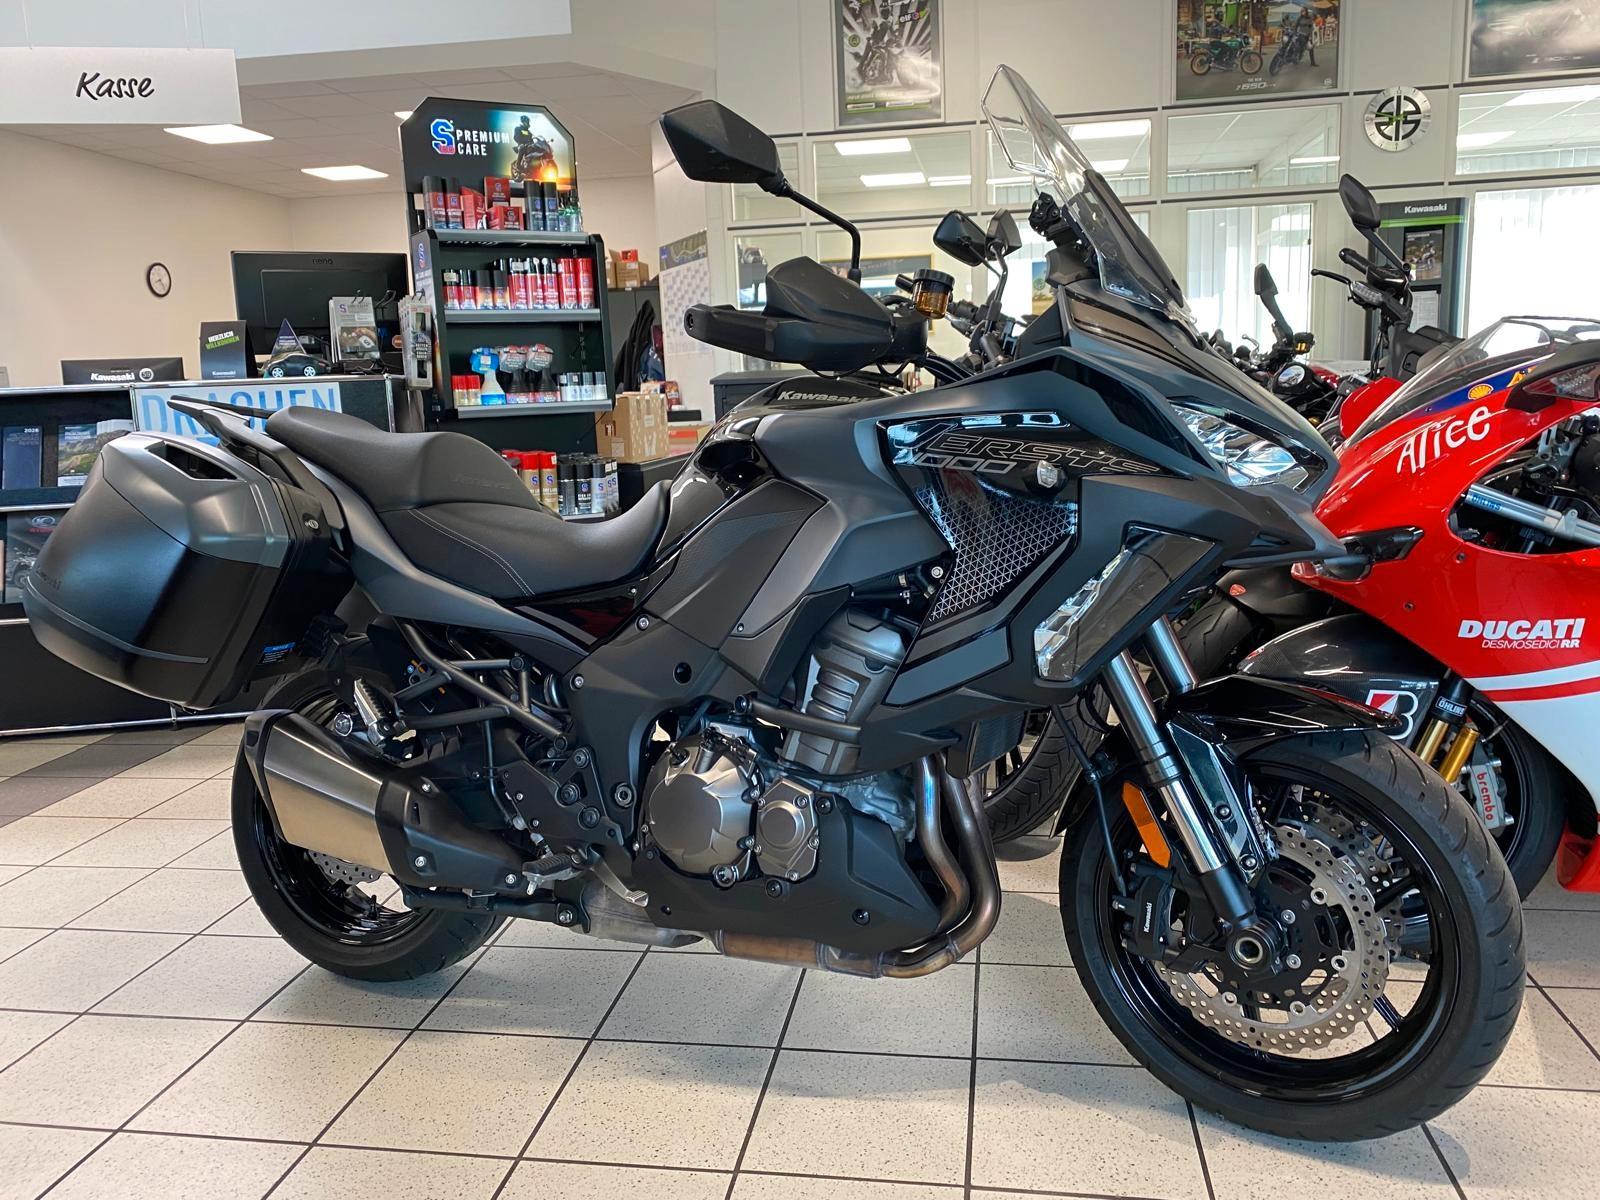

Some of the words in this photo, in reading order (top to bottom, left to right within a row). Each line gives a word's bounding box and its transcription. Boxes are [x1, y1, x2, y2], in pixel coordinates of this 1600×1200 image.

[76, 72, 155, 101] Kasse
[456, 129, 510, 144] PREMIUM
[457, 143, 488, 156] CARE
[1404, 203, 1447, 214] Kawasaki
[90, 372, 135, 382] Kawasaki
[778, 390, 868, 403] Kawasaki
[1458, 618, 1586, 639] DUCATI
[1482, 639, 1560, 649] DESMOSEDICI
[1560, 639, 1580, 649] RR
[1476, 772, 1495, 820] brembo
[1143, 901, 1152, 932] Kawasaki
